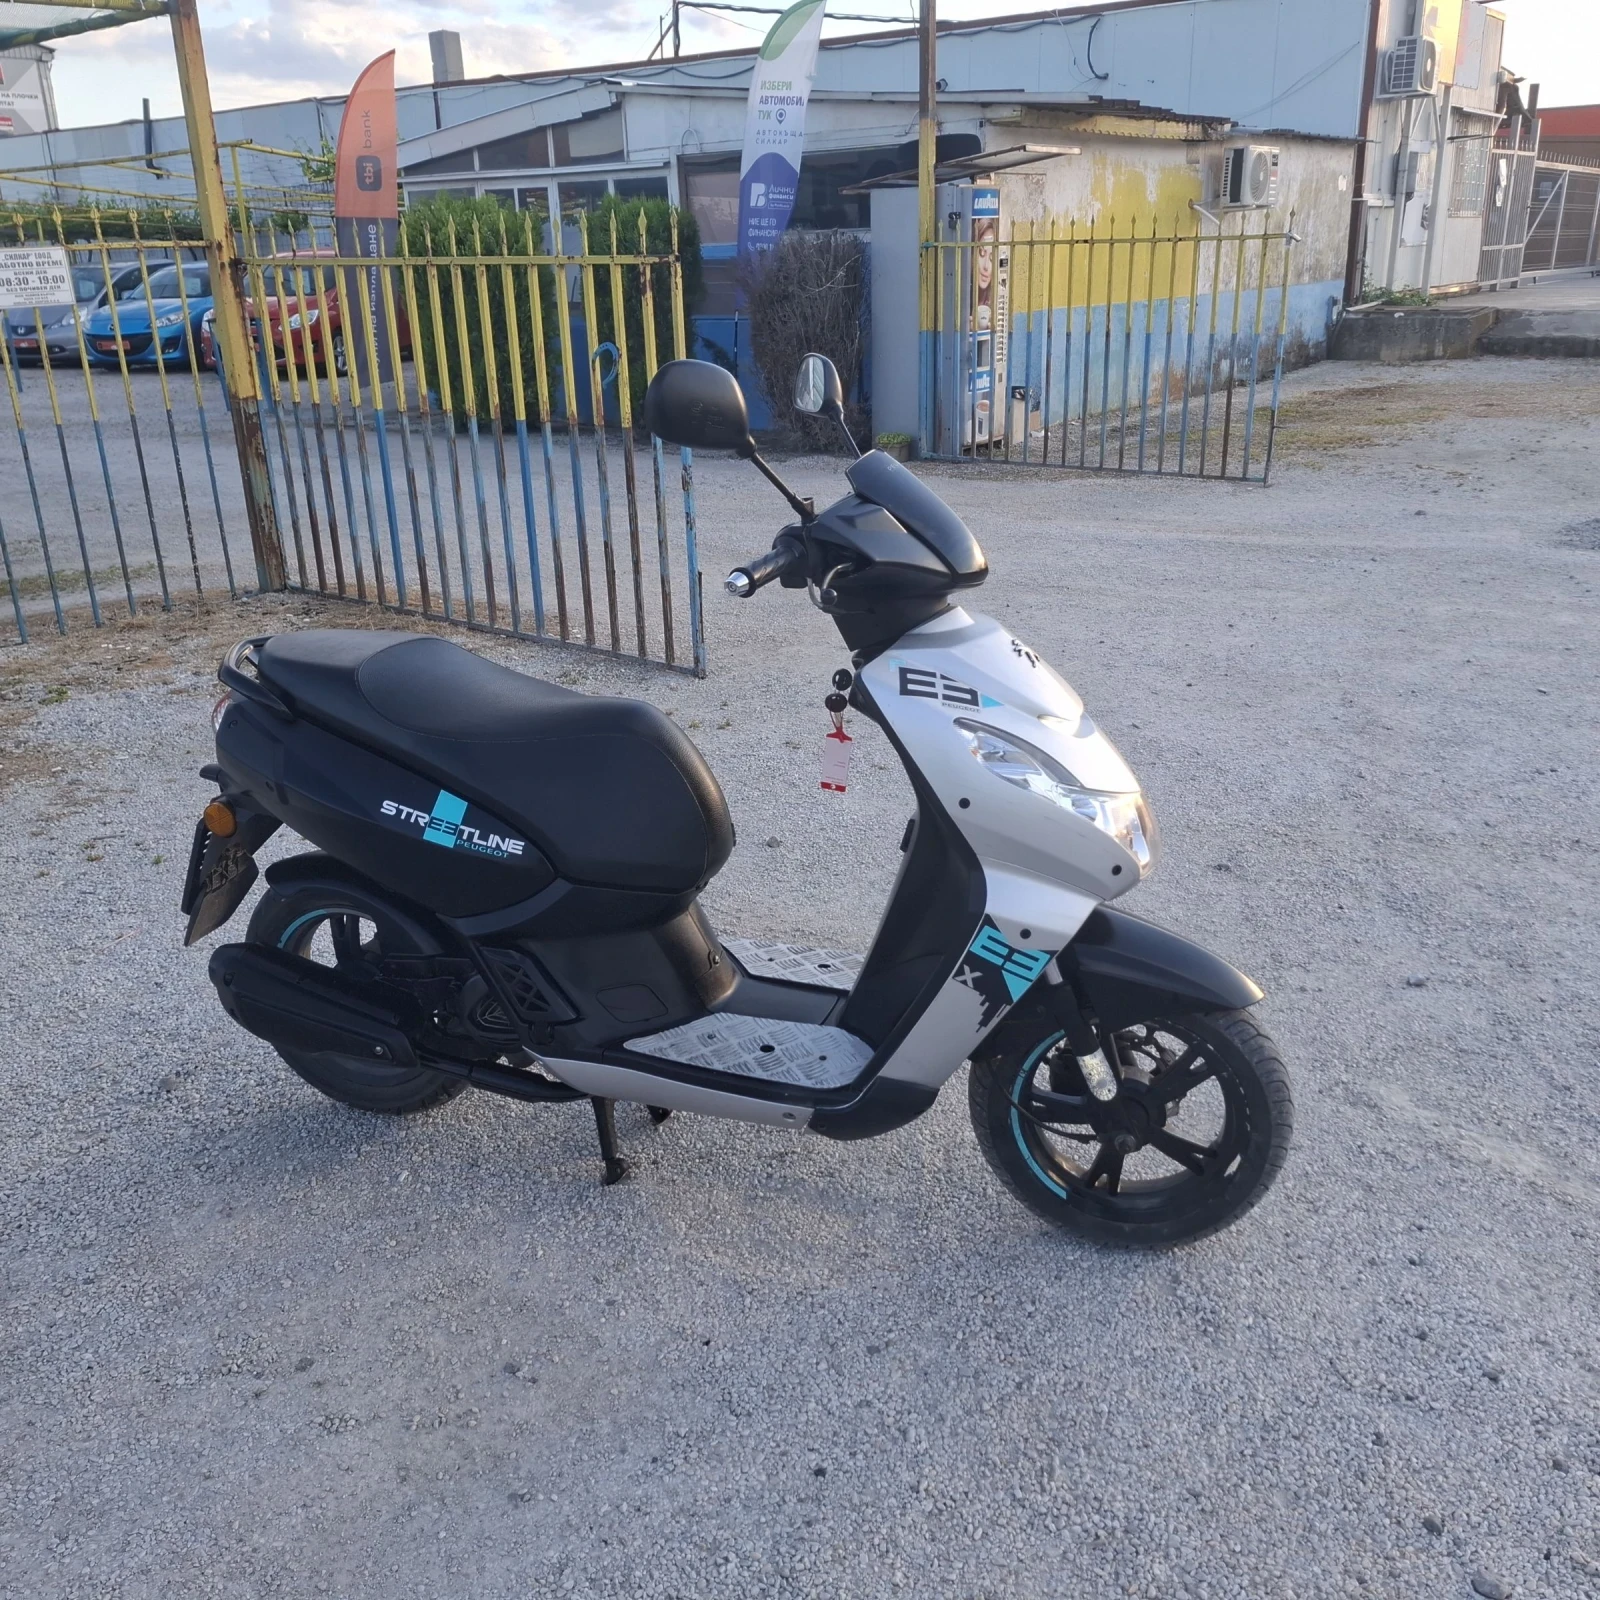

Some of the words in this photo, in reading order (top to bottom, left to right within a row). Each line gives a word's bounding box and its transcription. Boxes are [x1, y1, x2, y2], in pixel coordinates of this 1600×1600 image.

[760, 80, 792, 91] ИЗБЕРИ
[758, 109, 772, 120] ТУК
[361, 109, 372, 149] bank
[363, 162, 374, 185] tbi
[38, 275, 65, 285] 19:00
[942, 702, 981, 713] PEUGEOT
[457, 839, 509, 858] PEUGEOT
